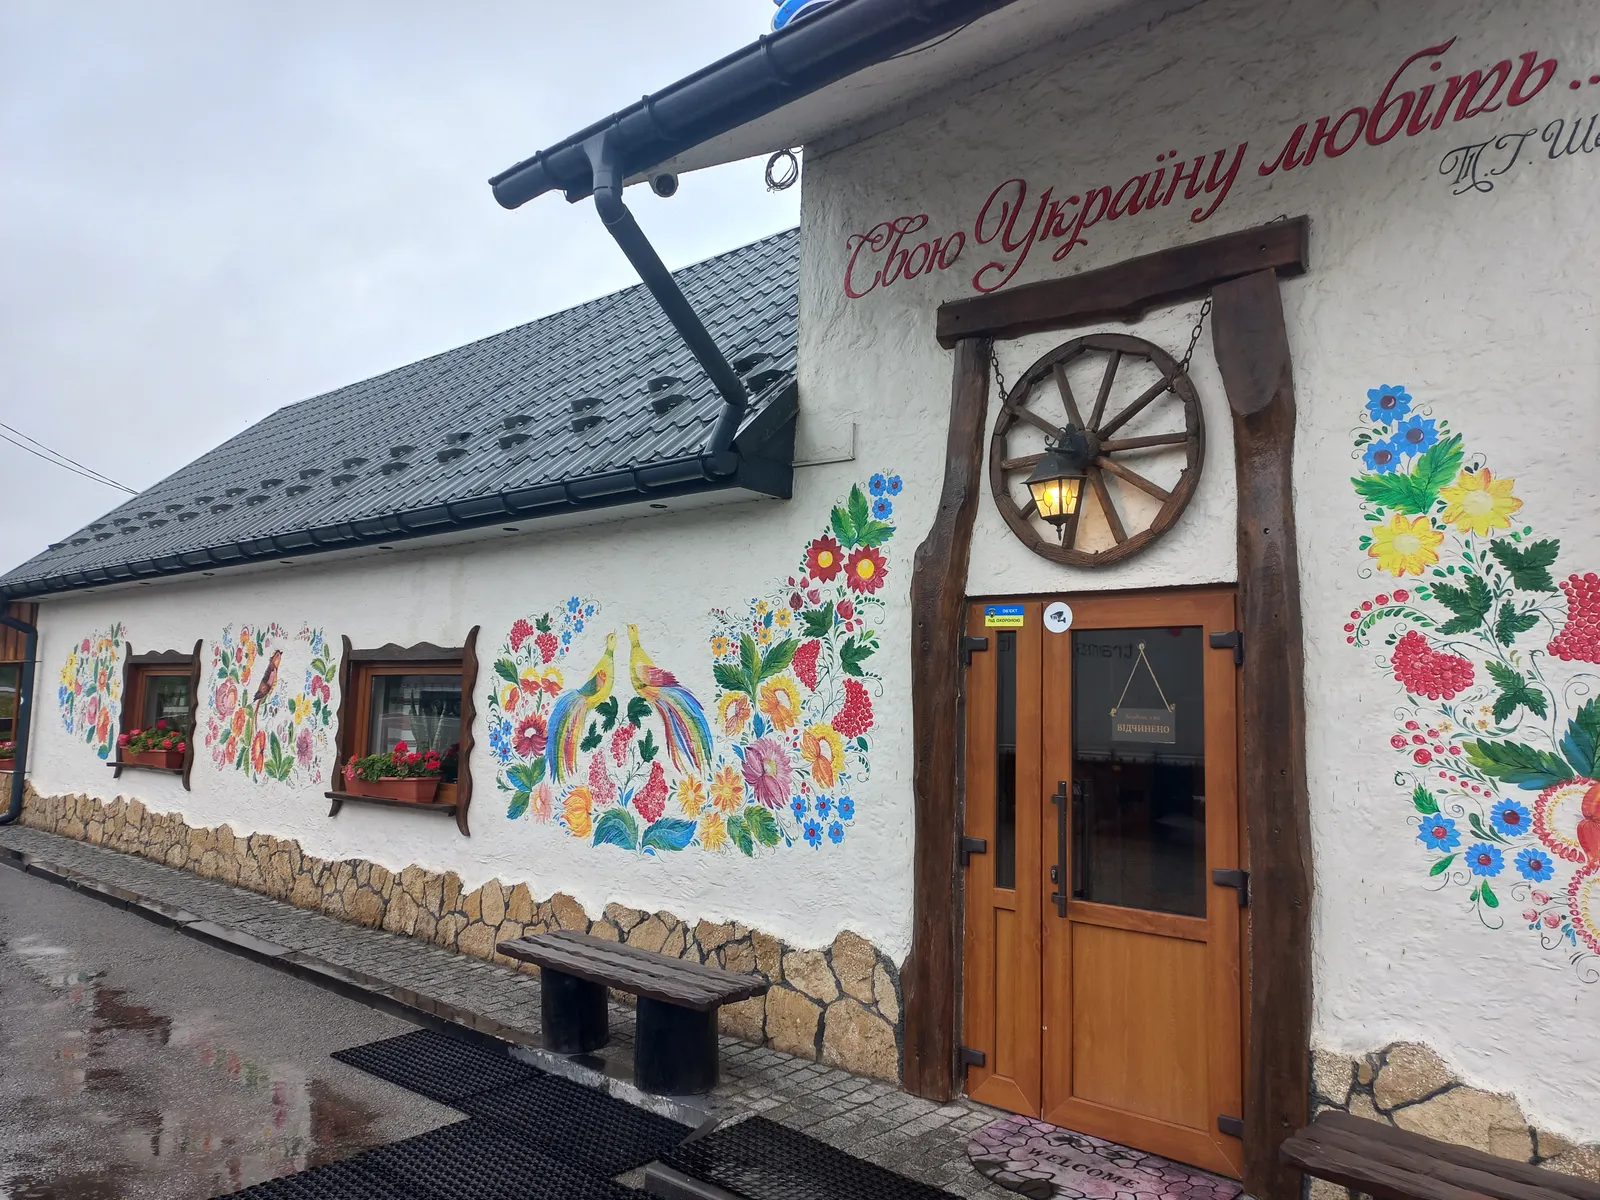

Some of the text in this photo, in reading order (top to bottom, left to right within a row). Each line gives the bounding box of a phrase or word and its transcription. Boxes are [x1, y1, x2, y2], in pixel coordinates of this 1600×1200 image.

[844, 214, 966, 299] Свою
[971, 141, 1249, 293] Україну
[1117, 723, 1171, 735] ВІДЧИНЕНО
[1028, 1147, 1140, 1189] WELCOME
